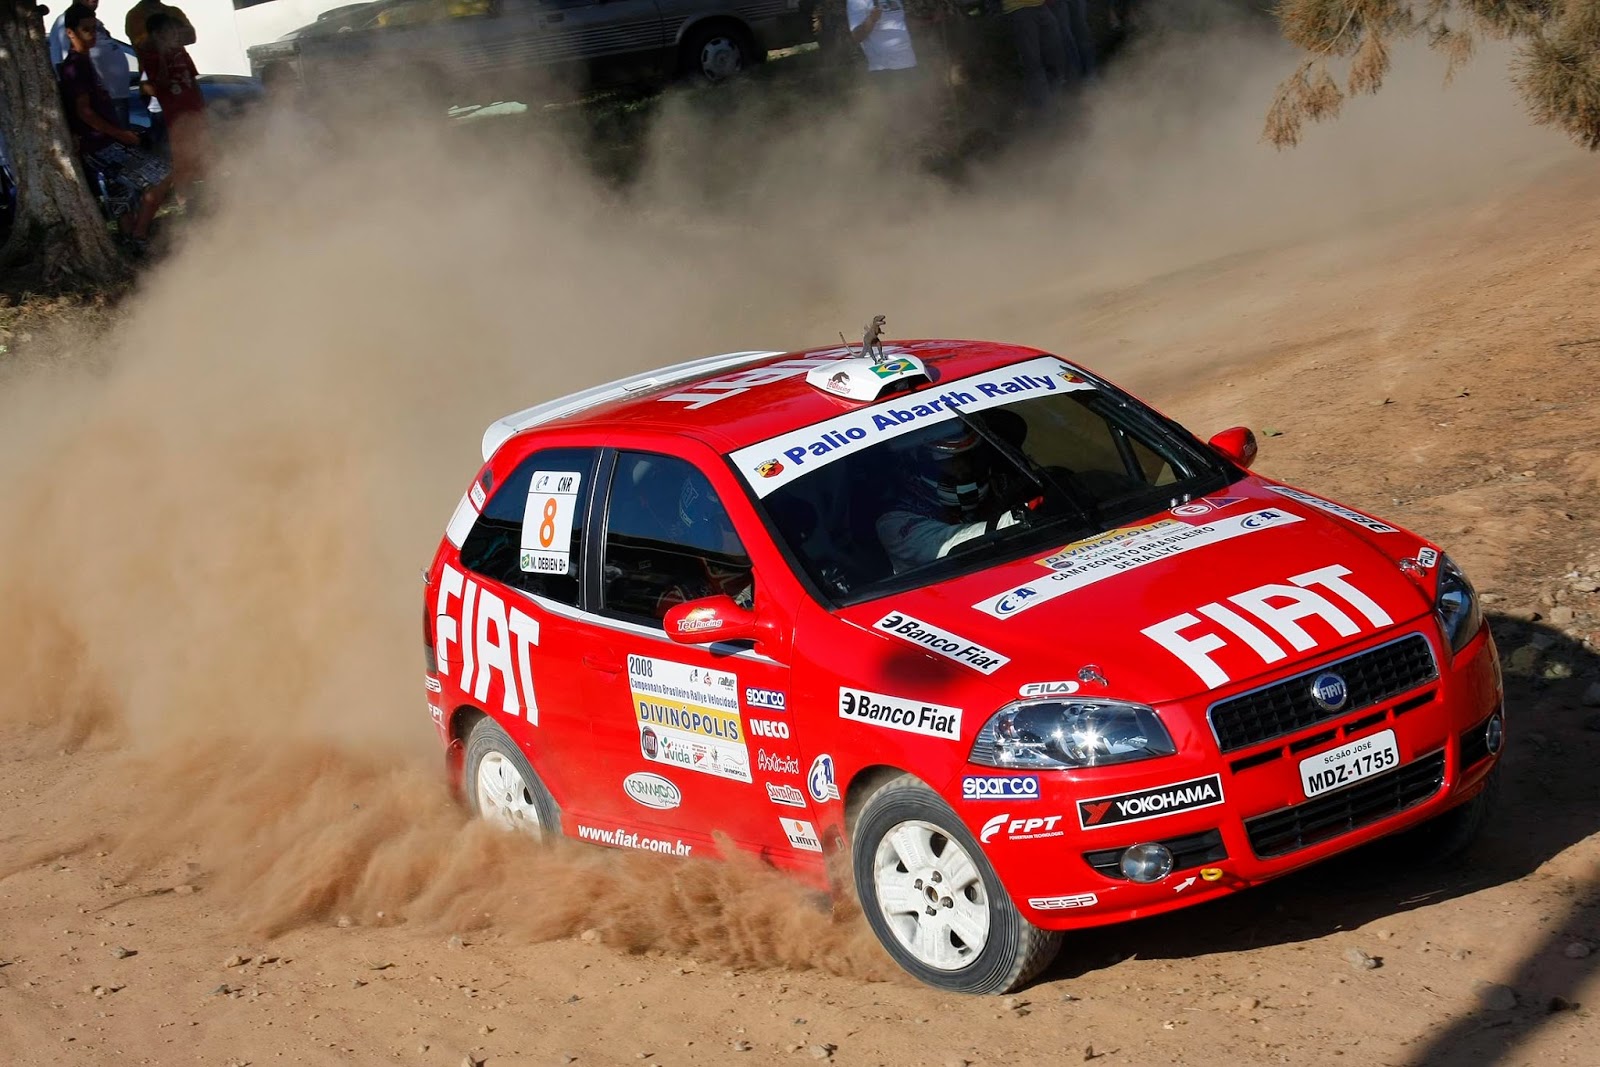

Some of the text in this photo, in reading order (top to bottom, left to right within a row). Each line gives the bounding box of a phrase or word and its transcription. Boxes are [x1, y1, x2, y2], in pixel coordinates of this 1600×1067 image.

[784, 375, 1057, 465] Palio Abarth Rally
[557, 476, 573, 492] CNR
[539, 497, 557, 548] 8
[538, 557, 558, 571] DEBIEN
[1051, 527, 1216, 581] CAMPEONATO BRASILEIRO
[1113, 545, 1184, 570] DE RALLYE
[1140, 564, 1394, 690] FIAT
[436, 563, 540, 727] FIAT
[896, 621, 1000, 670] Banco Fiat
[629, 656, 653, 678] 2008
[631, 677, 663, 692] Campeonato
[662, 684, 690, 699] Brasileiro
[708, 693, 738, 709] Velocidade
[746, 688, 784, 706] sparco
[1026, 682, 1070, 694] FILA
[1320, 682, 1342, 700] FIAT
[640, 701, 739, 740] DIVINÓPOLIS
[750, 718, 790, 739] IVECO
[857, 695, 956, 734] Banco Fiat
[1323, 741, 1373, 764] SC-SÃO JOSÉ
[1308, 747, 1395, 793] MDZ-1755
[963, 777, 1037, 799] sparco
[1116, 783, 1216, 817] YOKOHAMA
[1008, 815, 1062, 833] FPT
[577, 824, 692, 857] www.fiat.com.br
